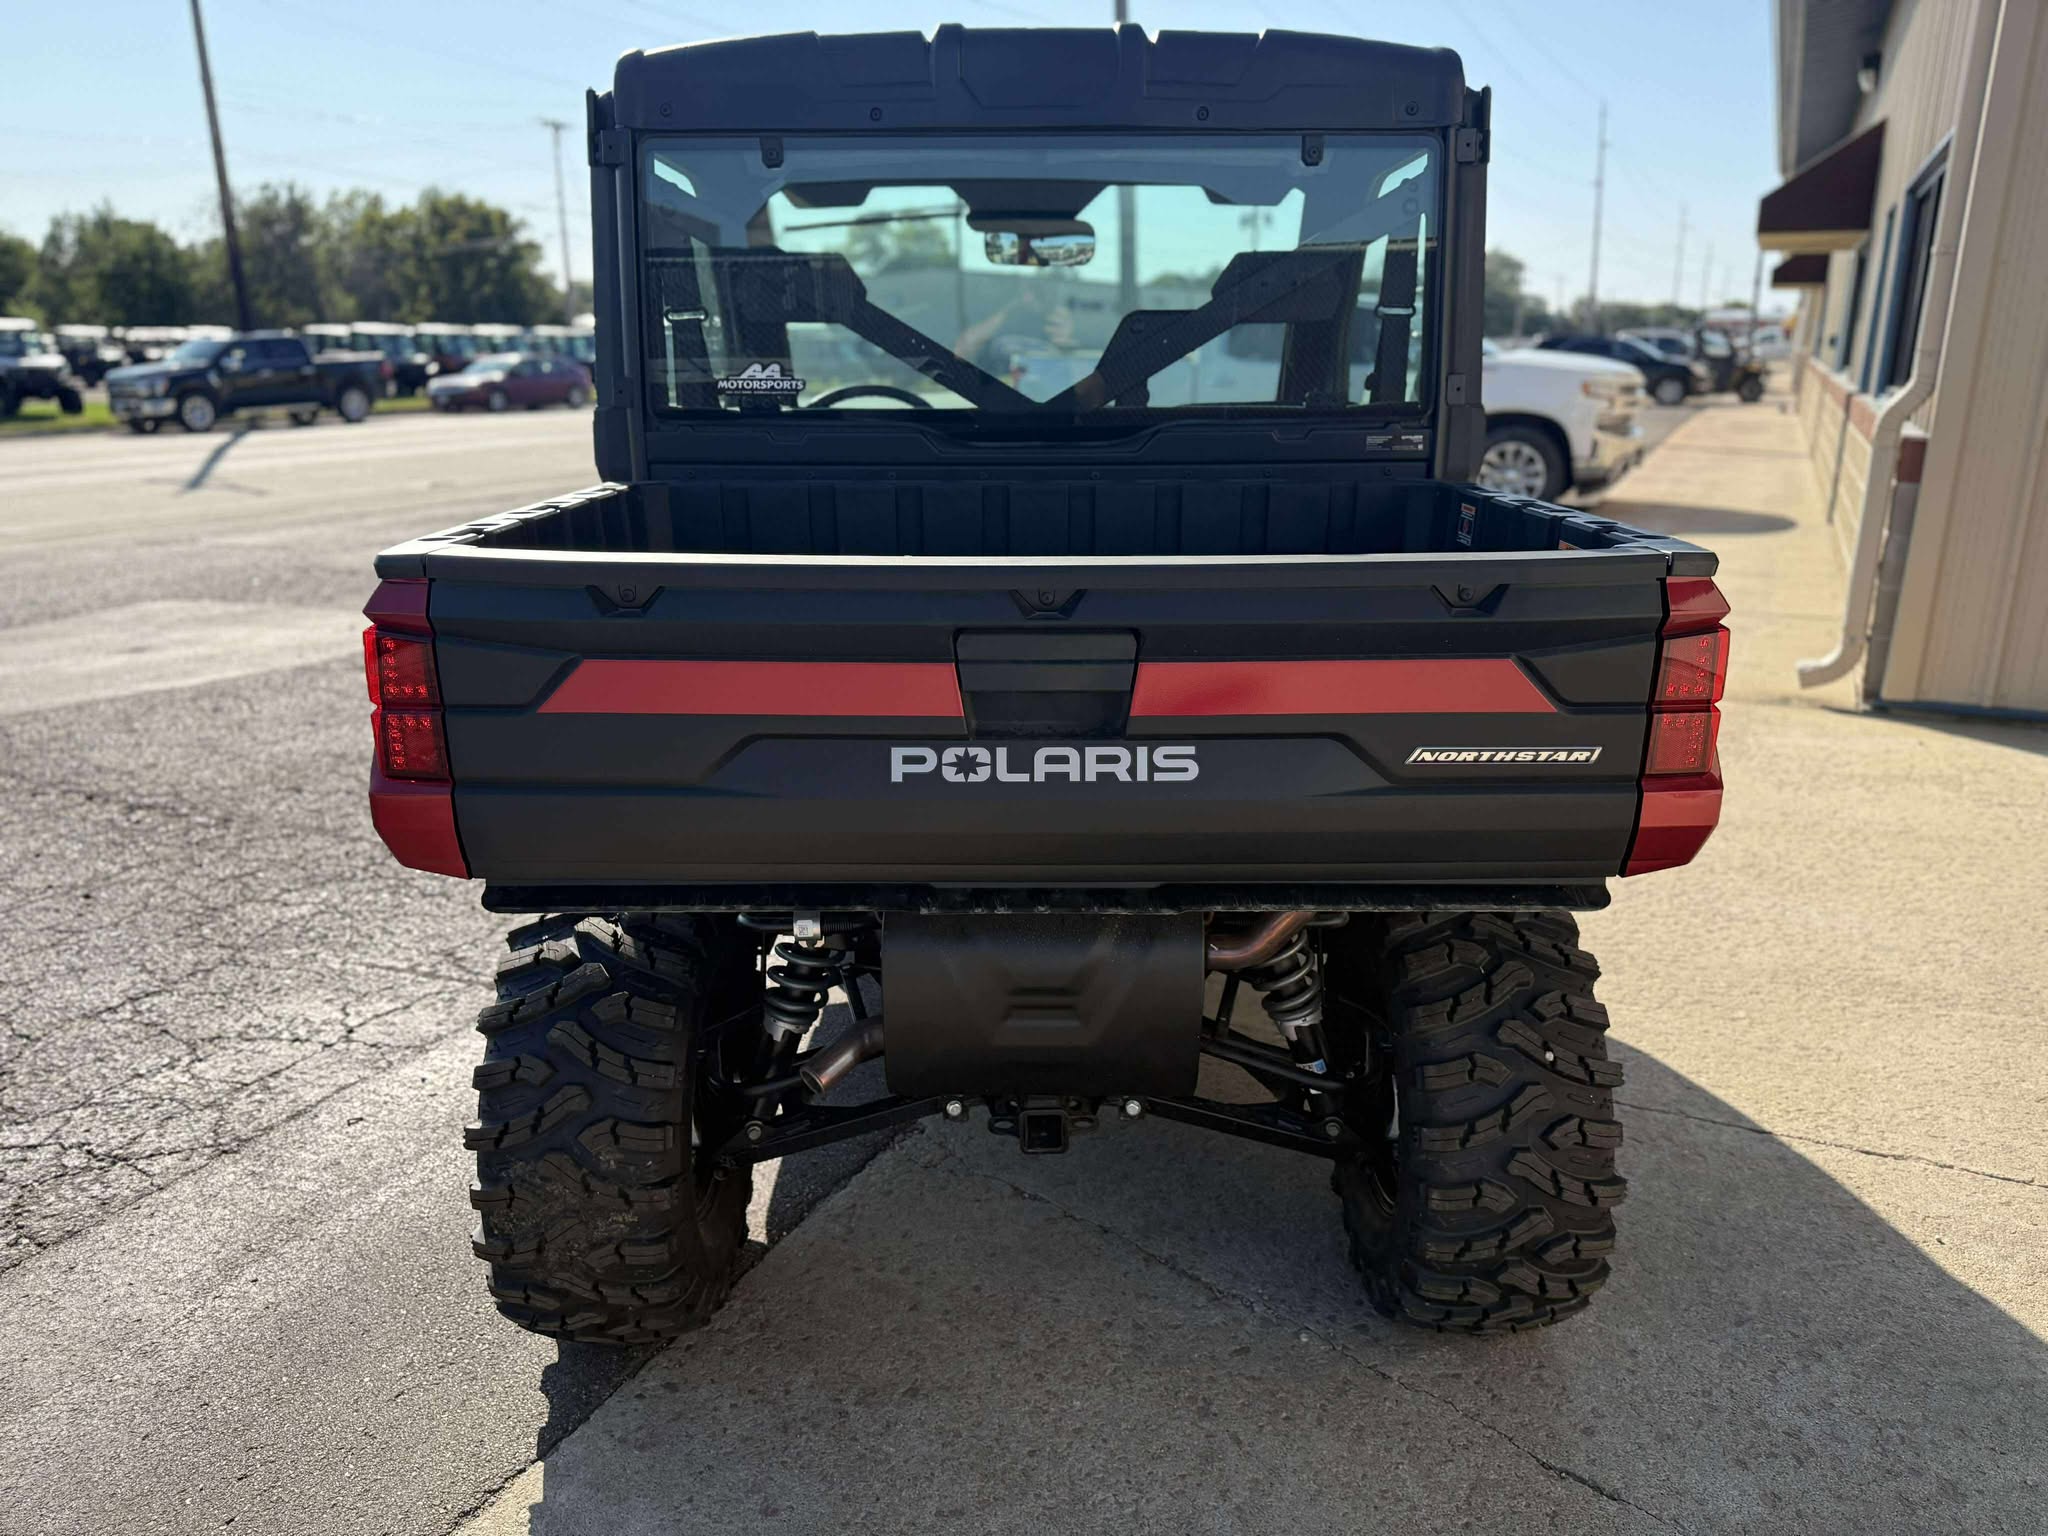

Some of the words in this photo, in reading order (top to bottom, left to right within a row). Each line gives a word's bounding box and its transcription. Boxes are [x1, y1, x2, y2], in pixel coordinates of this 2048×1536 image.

[717, 380, 804, 390] MOTORSPORTS
[1416, 751, 1591, 763] NORTHSTAR
[891, 746, 1199, 782] POLARIS
